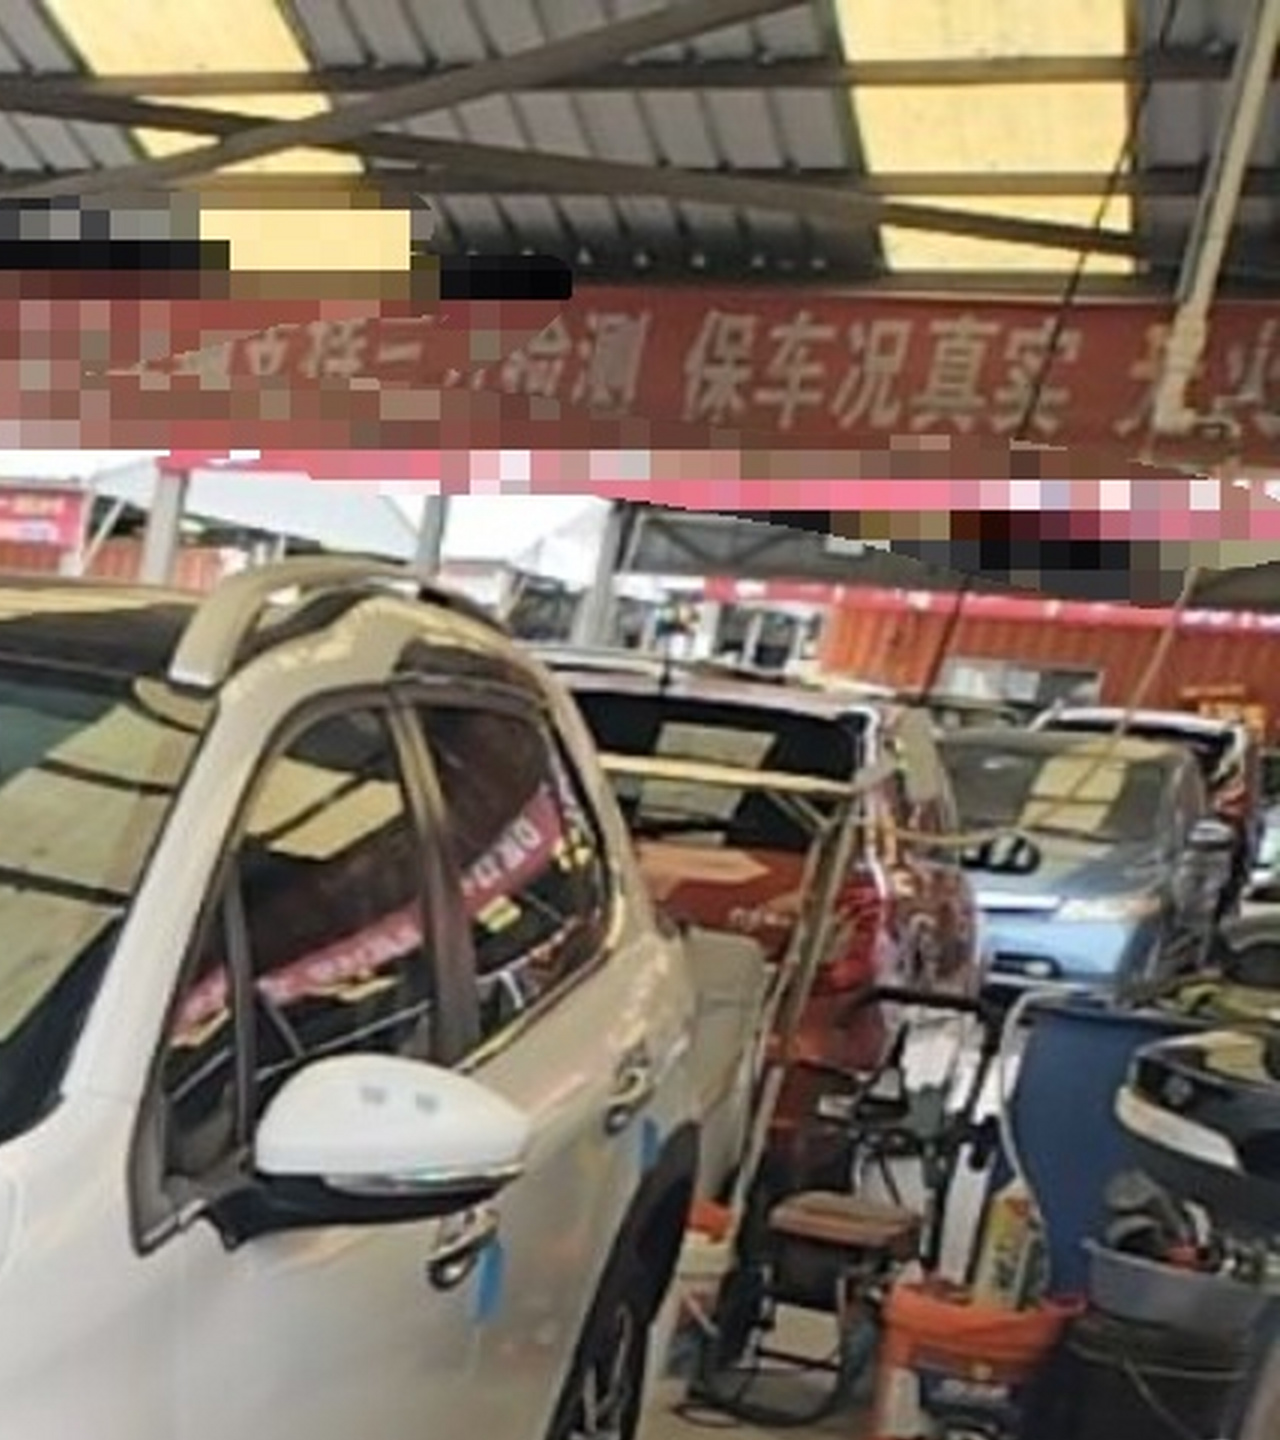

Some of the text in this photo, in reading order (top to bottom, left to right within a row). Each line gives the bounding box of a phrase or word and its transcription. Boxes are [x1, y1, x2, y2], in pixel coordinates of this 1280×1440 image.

[680, 308, 1082, 434] 保车况真实
